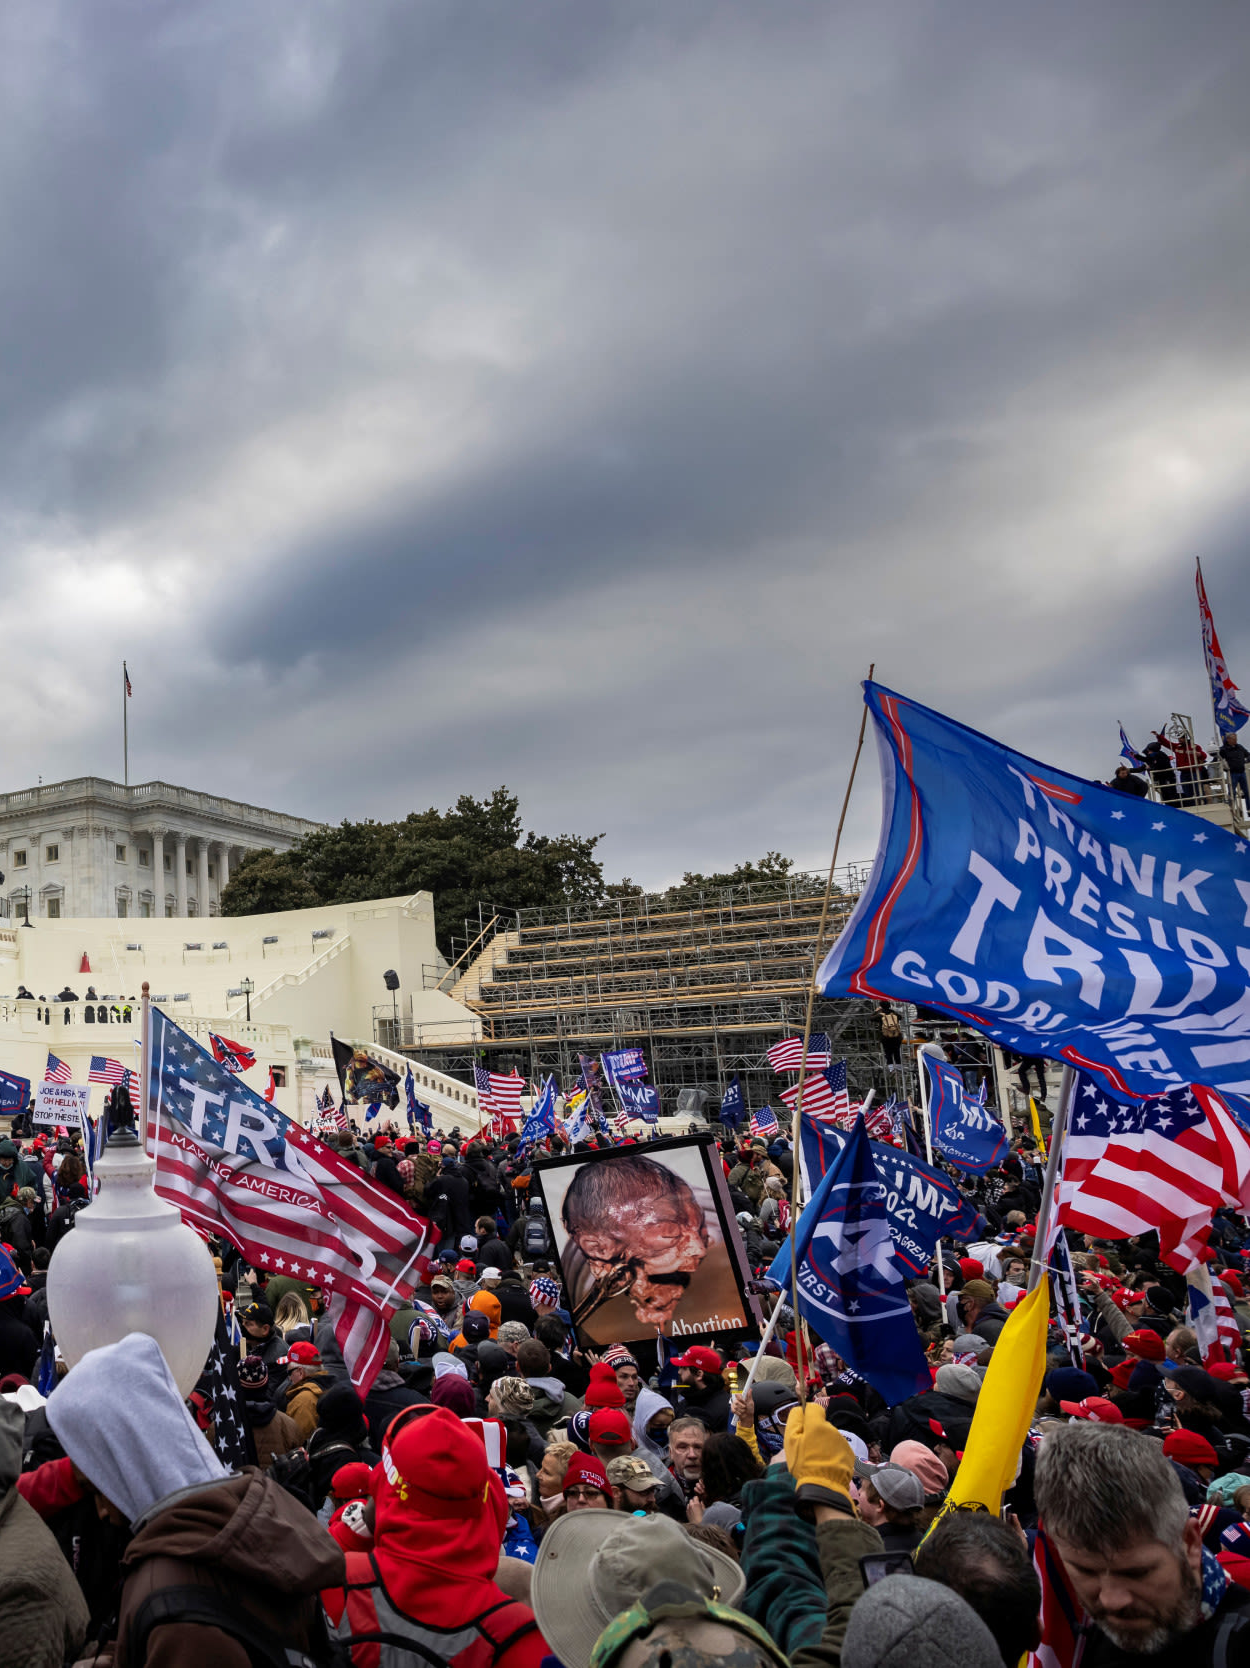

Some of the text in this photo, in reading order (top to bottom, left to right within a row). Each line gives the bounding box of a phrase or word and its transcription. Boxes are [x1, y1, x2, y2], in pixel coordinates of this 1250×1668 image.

[1006, 763, 1215, 917] THANK
[891, 950, 1021, 1013] GOD
[40, 1087, 54, 1096] JOE
[55, 1088, 60, 1096] &
[60, 1089, 71, 1097] HIS
[43, 1097, 54, 1105] OH
[55, 1098, 71, 1107] HELL
[34, 1111, 54, 1119] STOP
[54, 1112, 67, 1121] THE
[171, 1133, 322, 1214] MAKING AMERICA
[797, 1260, 839, 1304] FIRST
[672, 1314, 743, 1337] Abortion
[580, 1469, 605, 1485] Trump
